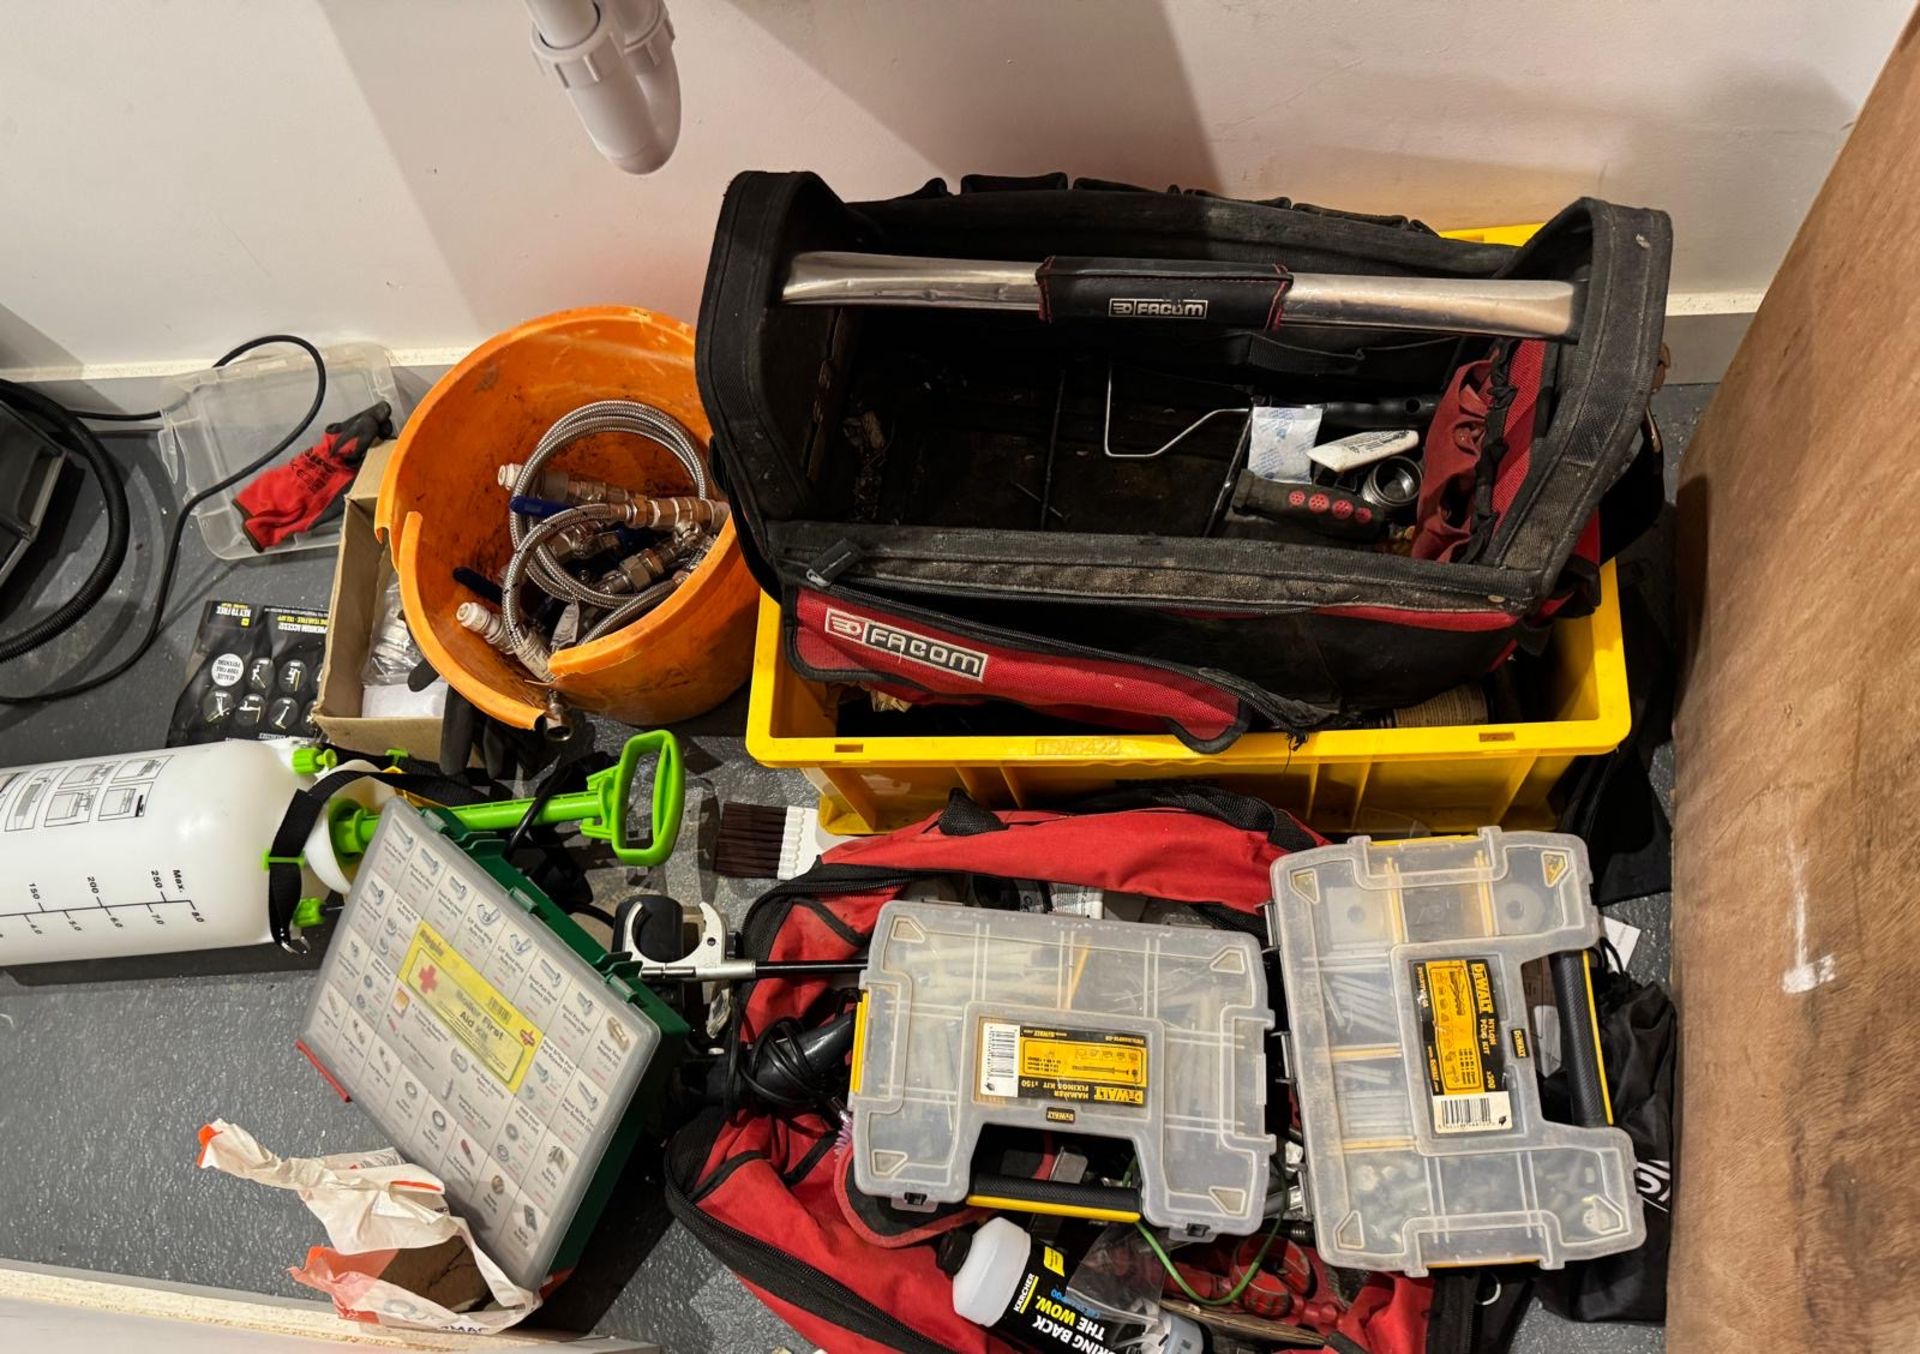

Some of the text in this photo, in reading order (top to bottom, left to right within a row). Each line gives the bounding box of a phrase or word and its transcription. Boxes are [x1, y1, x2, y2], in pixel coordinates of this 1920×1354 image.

[1137, 303, 1203, 316] FACOM
[869, 628, 984, 673] FACOM
[87, 876, 99, 894] 200
[151, 870, 163, 889] 250
[29, 882, 40, 900] 150
[1471, 964, 1494, 1014] DEWALT
[459, 1009, 475, 1028] Aid
[481, 1015, 505, 1042] First
[1480, 1019, 1490, 1055] PLUG KIT
[1487, 1018, 1496, 1046] NYLON
[1513, 1030, 1526, 1057] DEWALT
[1054, 1091, 1088, 1099] HAMMER
[1058, 1083, 1088, 1091] FIXINGS
[1094, 1086, 1143, 1104] DEWALT
[1047, 1111, 1074, 1121] DEWALT
[1035, 1295, 1105, 1341] THE WOW.
[1032, 1315, 1073, 1344] BACK
